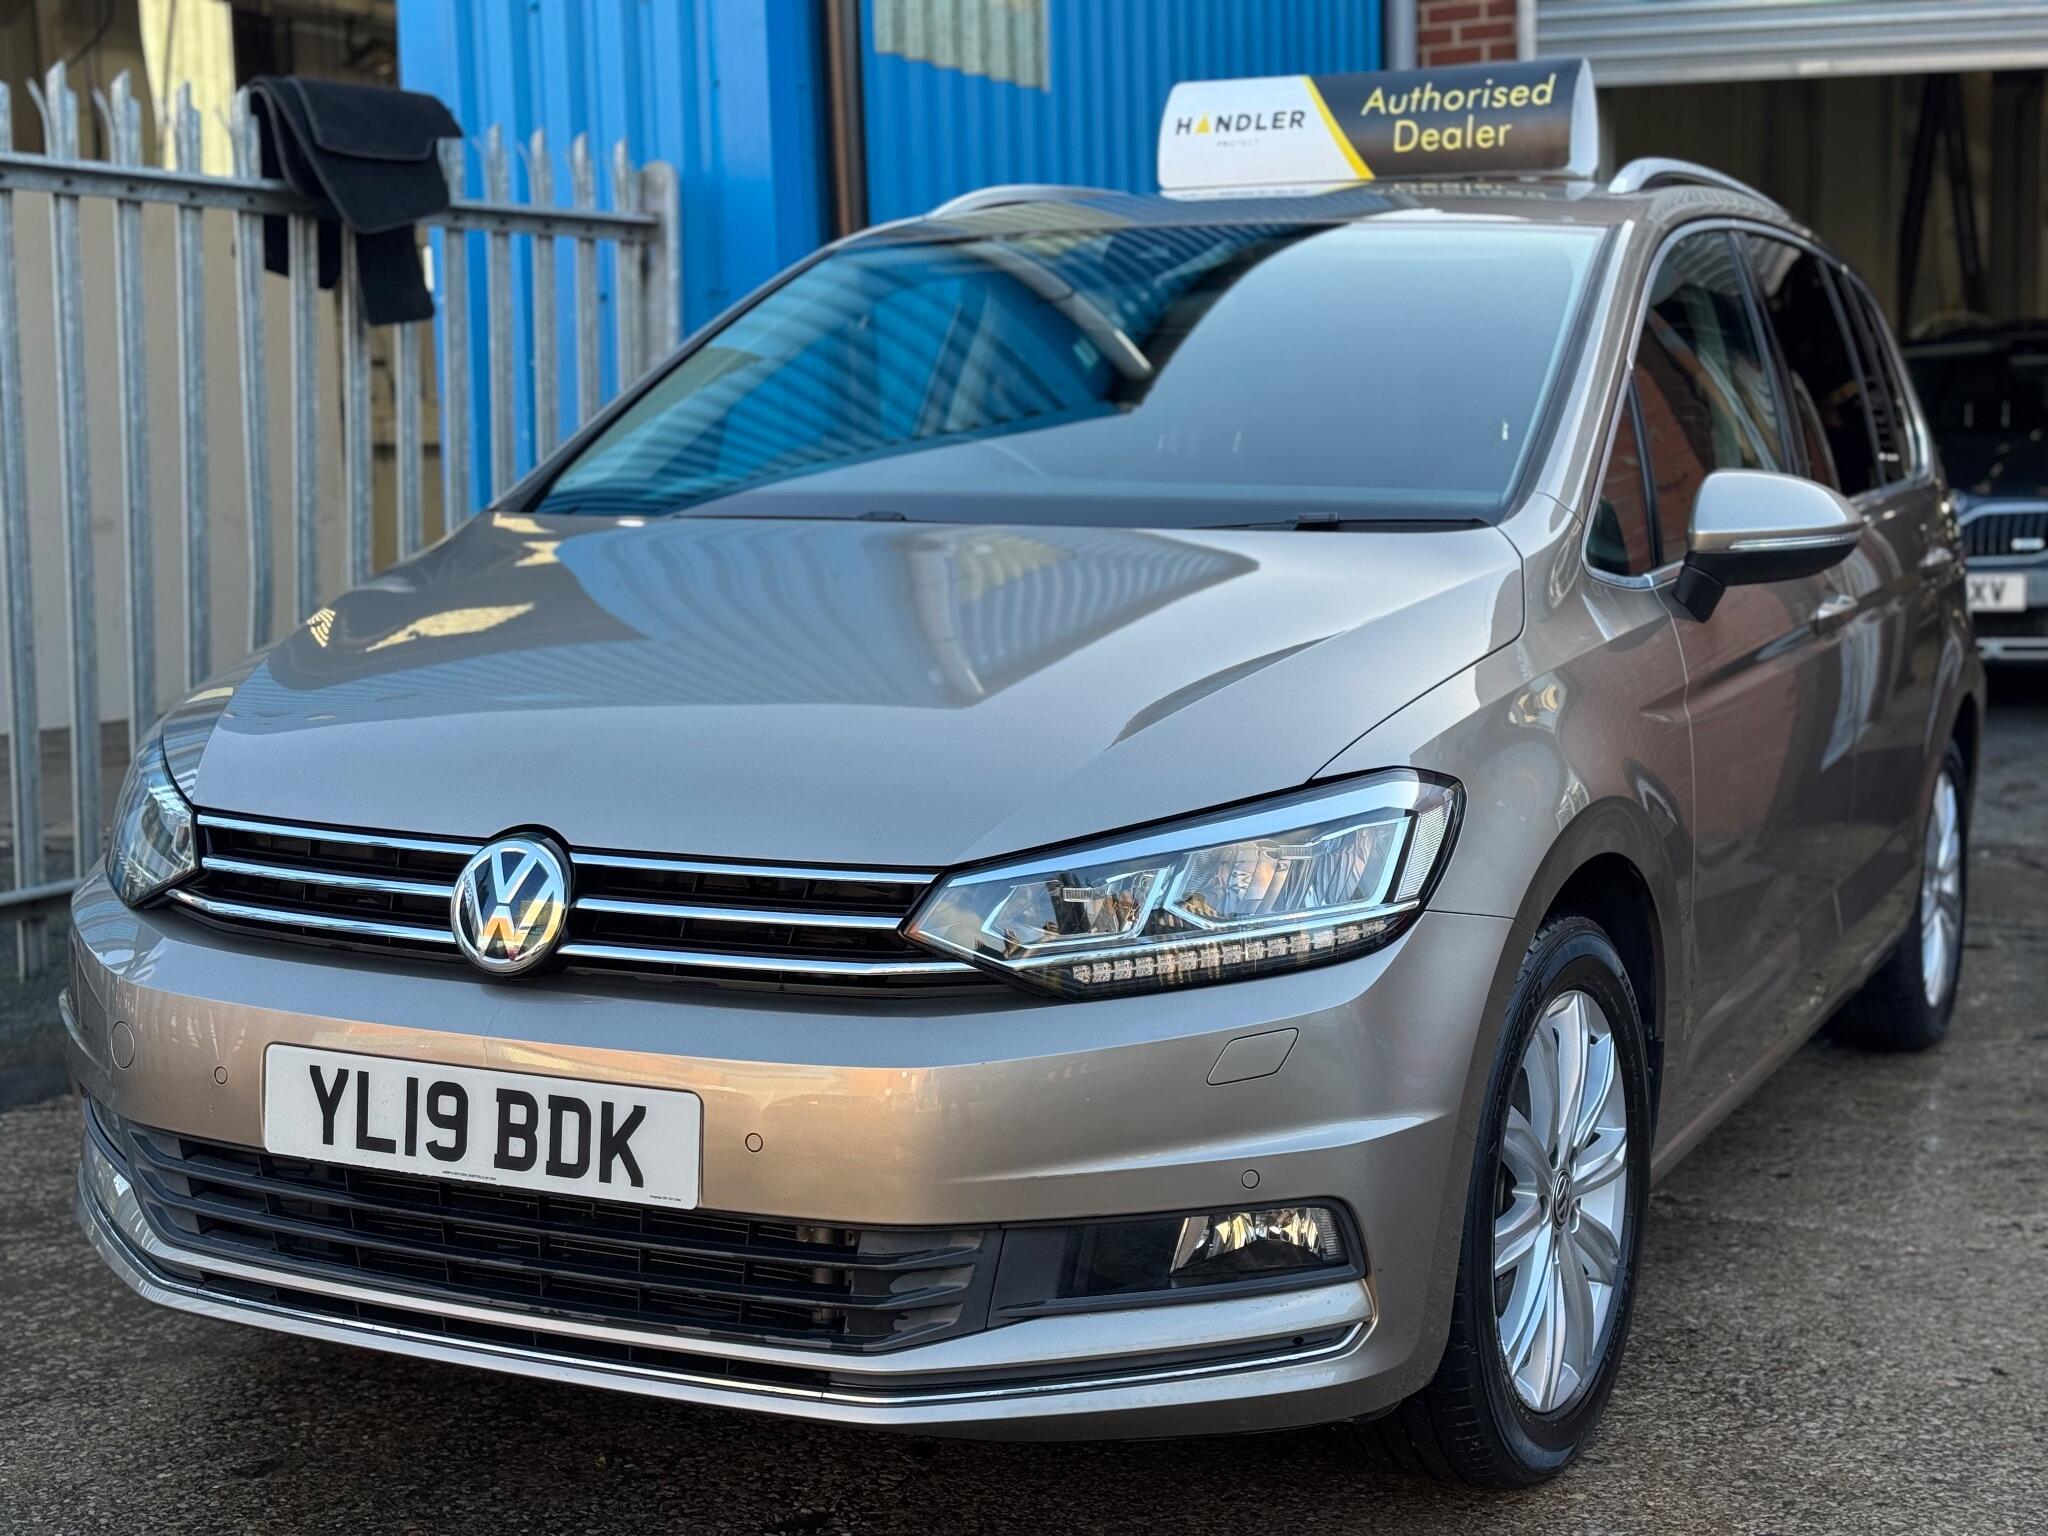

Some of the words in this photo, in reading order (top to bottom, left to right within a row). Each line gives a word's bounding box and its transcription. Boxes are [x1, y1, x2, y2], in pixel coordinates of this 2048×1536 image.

[1360, 72, 1557, 116] Authorised
[1176, 110, 1306, 135] HANDLER
[1394, 114, 1512, 153] Dealer
[309, 1064, 469, 1162] YL19
[494, 1087, 647, 1188] BDK
